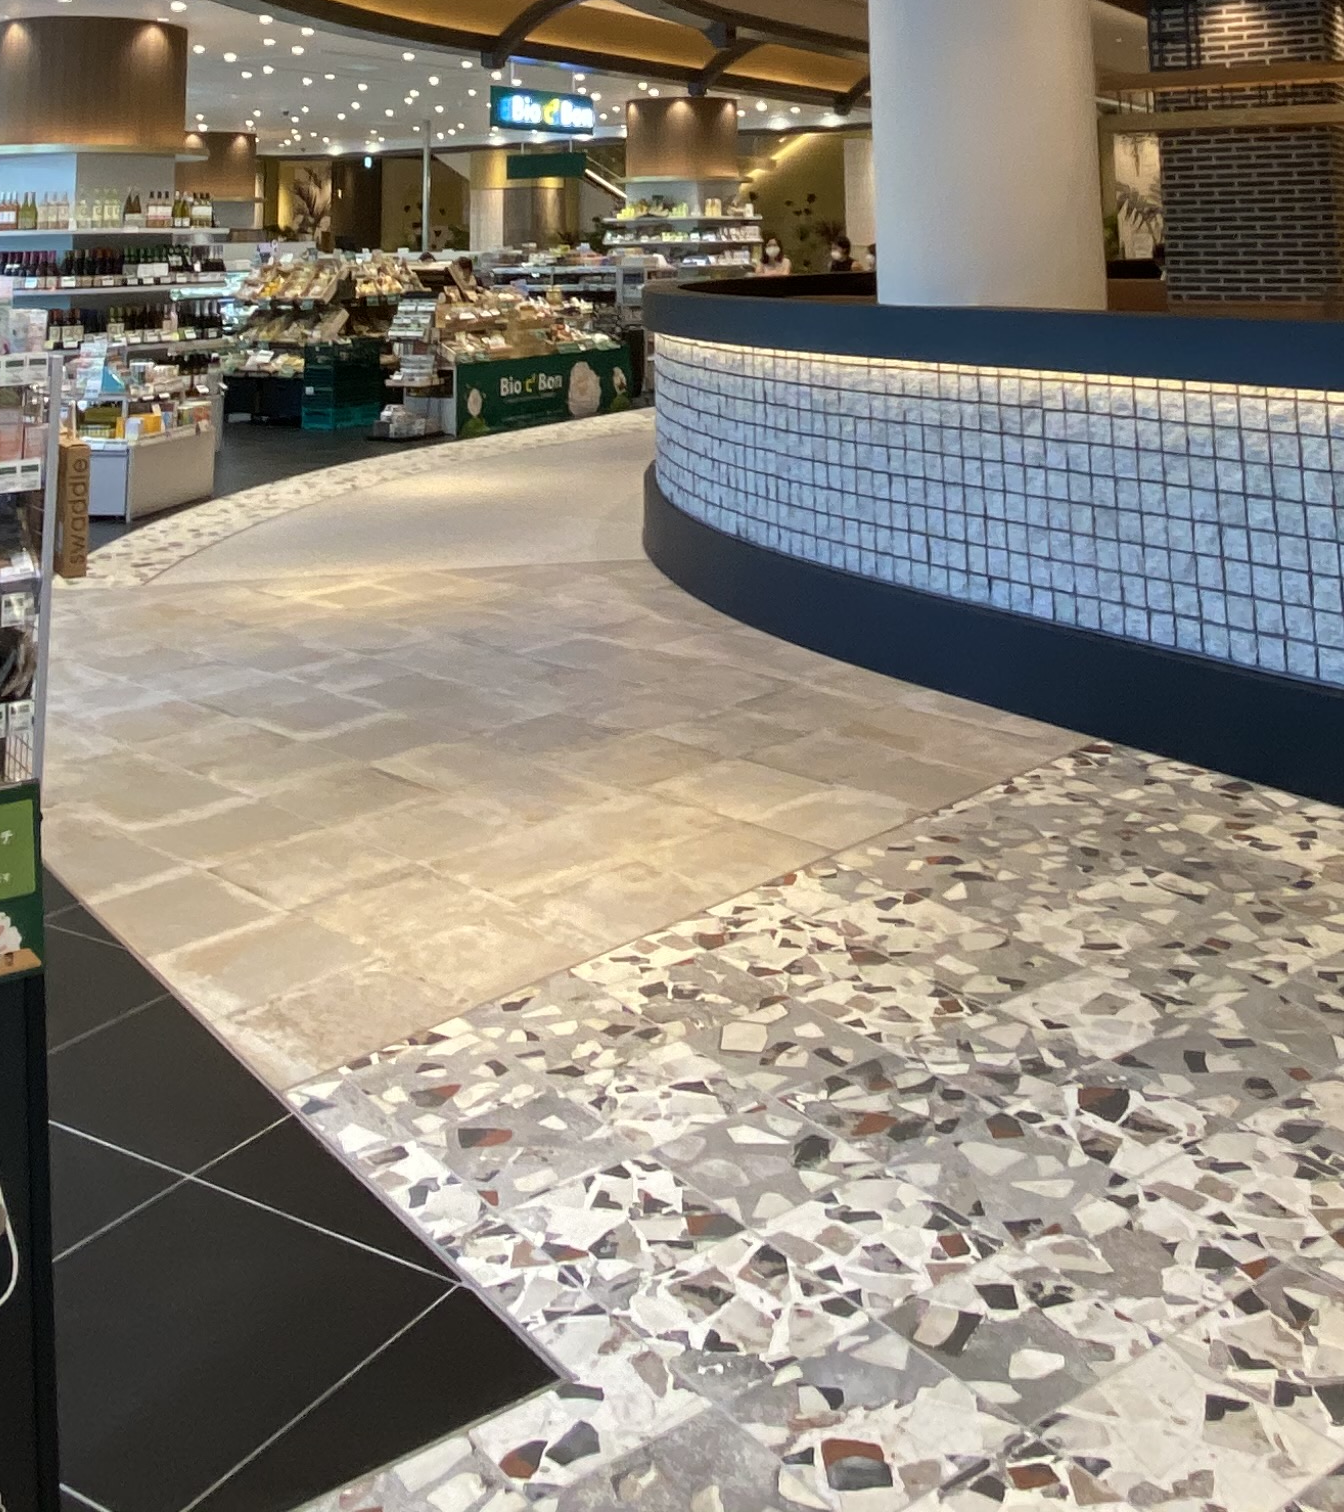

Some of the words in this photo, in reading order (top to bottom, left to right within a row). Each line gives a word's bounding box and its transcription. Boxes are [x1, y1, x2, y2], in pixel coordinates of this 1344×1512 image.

[511, 94, 542, 124] Bio
[500, 377, 522, 396] Bio
[538, 374, 562, 391] Bon
[69, 458, 88, 564] swaddle
